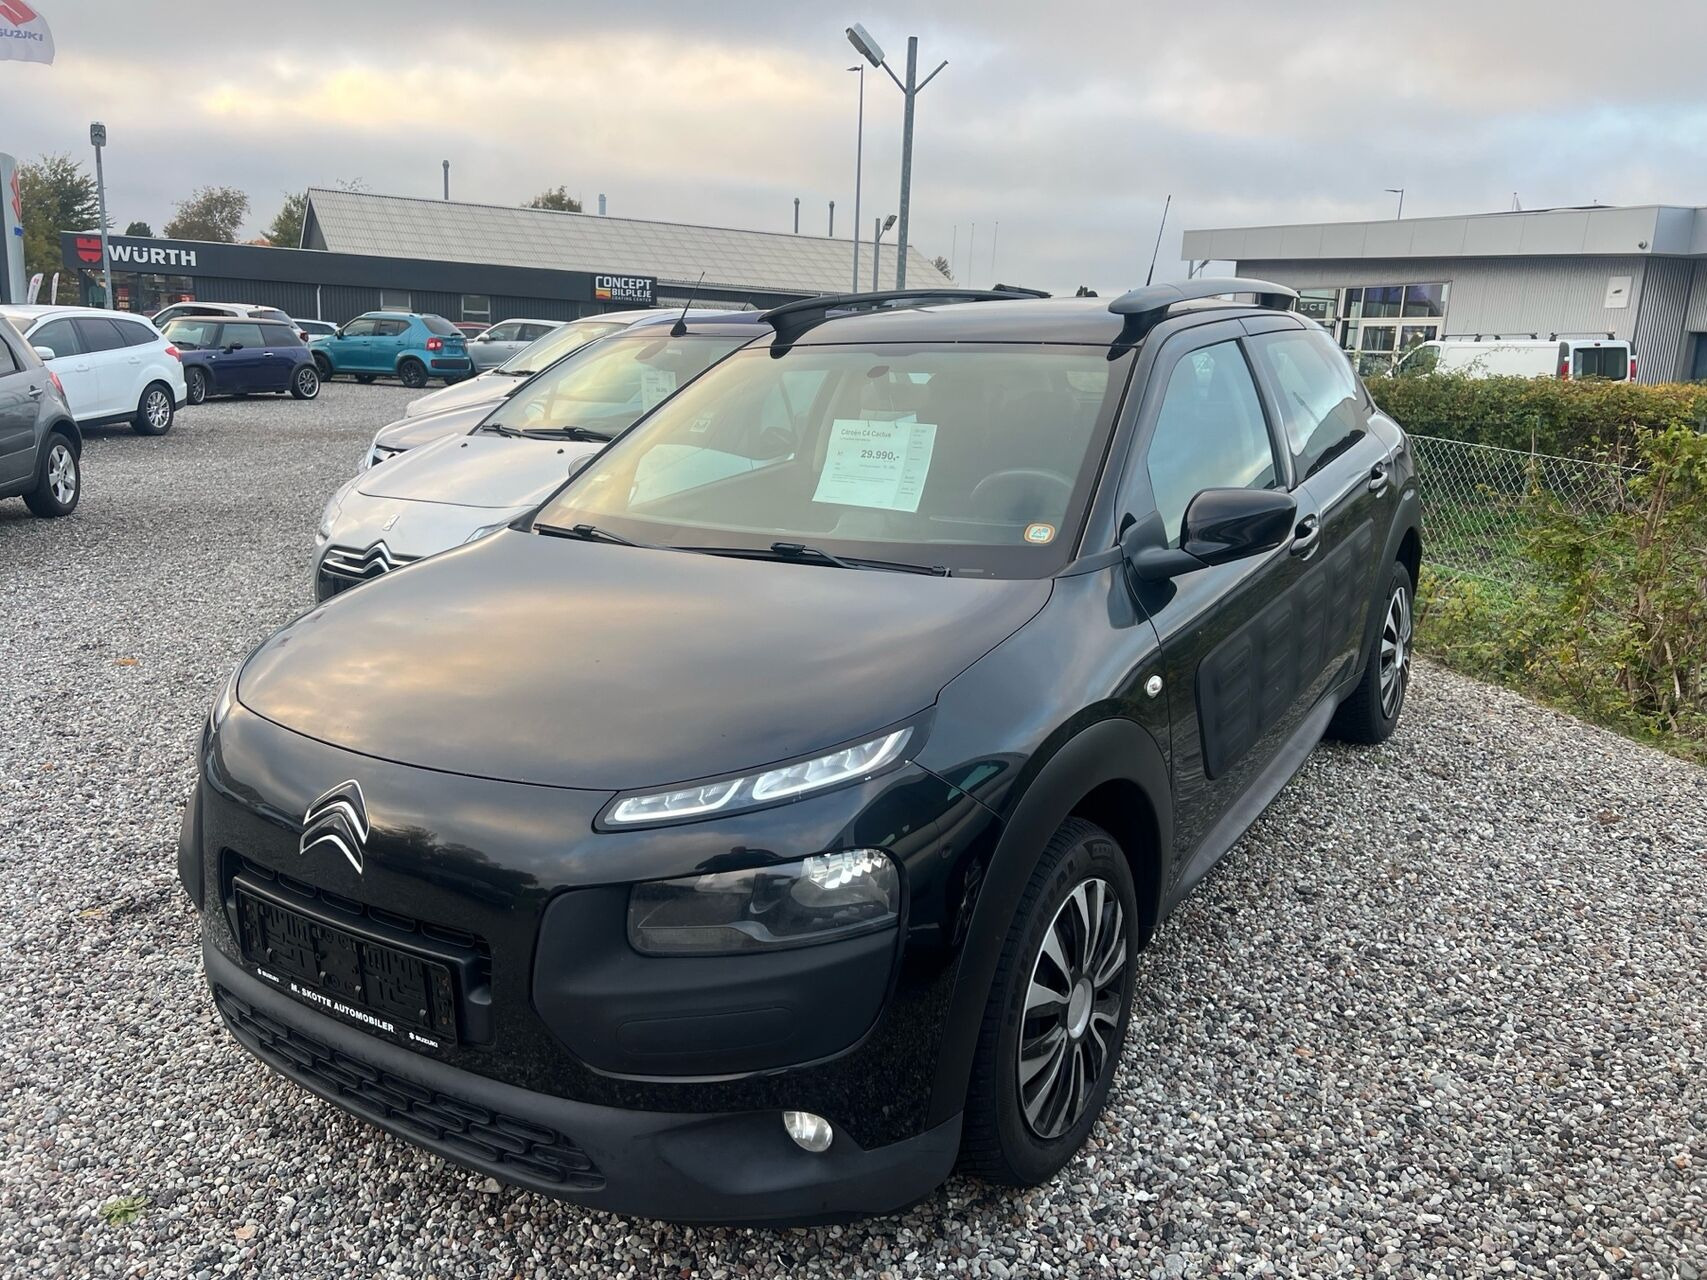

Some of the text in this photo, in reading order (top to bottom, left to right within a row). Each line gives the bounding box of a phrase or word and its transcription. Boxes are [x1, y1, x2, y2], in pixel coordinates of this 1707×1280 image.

[108, 245, 197, 267] WÜRTH
[595, 276, 651, 290] CONCEPT
[611, 288, 652, 298] BILPLEJE
[862, 429, 871, 437] C4
[860, 449, 900, 461] 29.990,-
[290, 983, 394, 1032] M. SKOTTE AUTOMOBILER
[415, 1035, 439, 1048] SUZUKI
